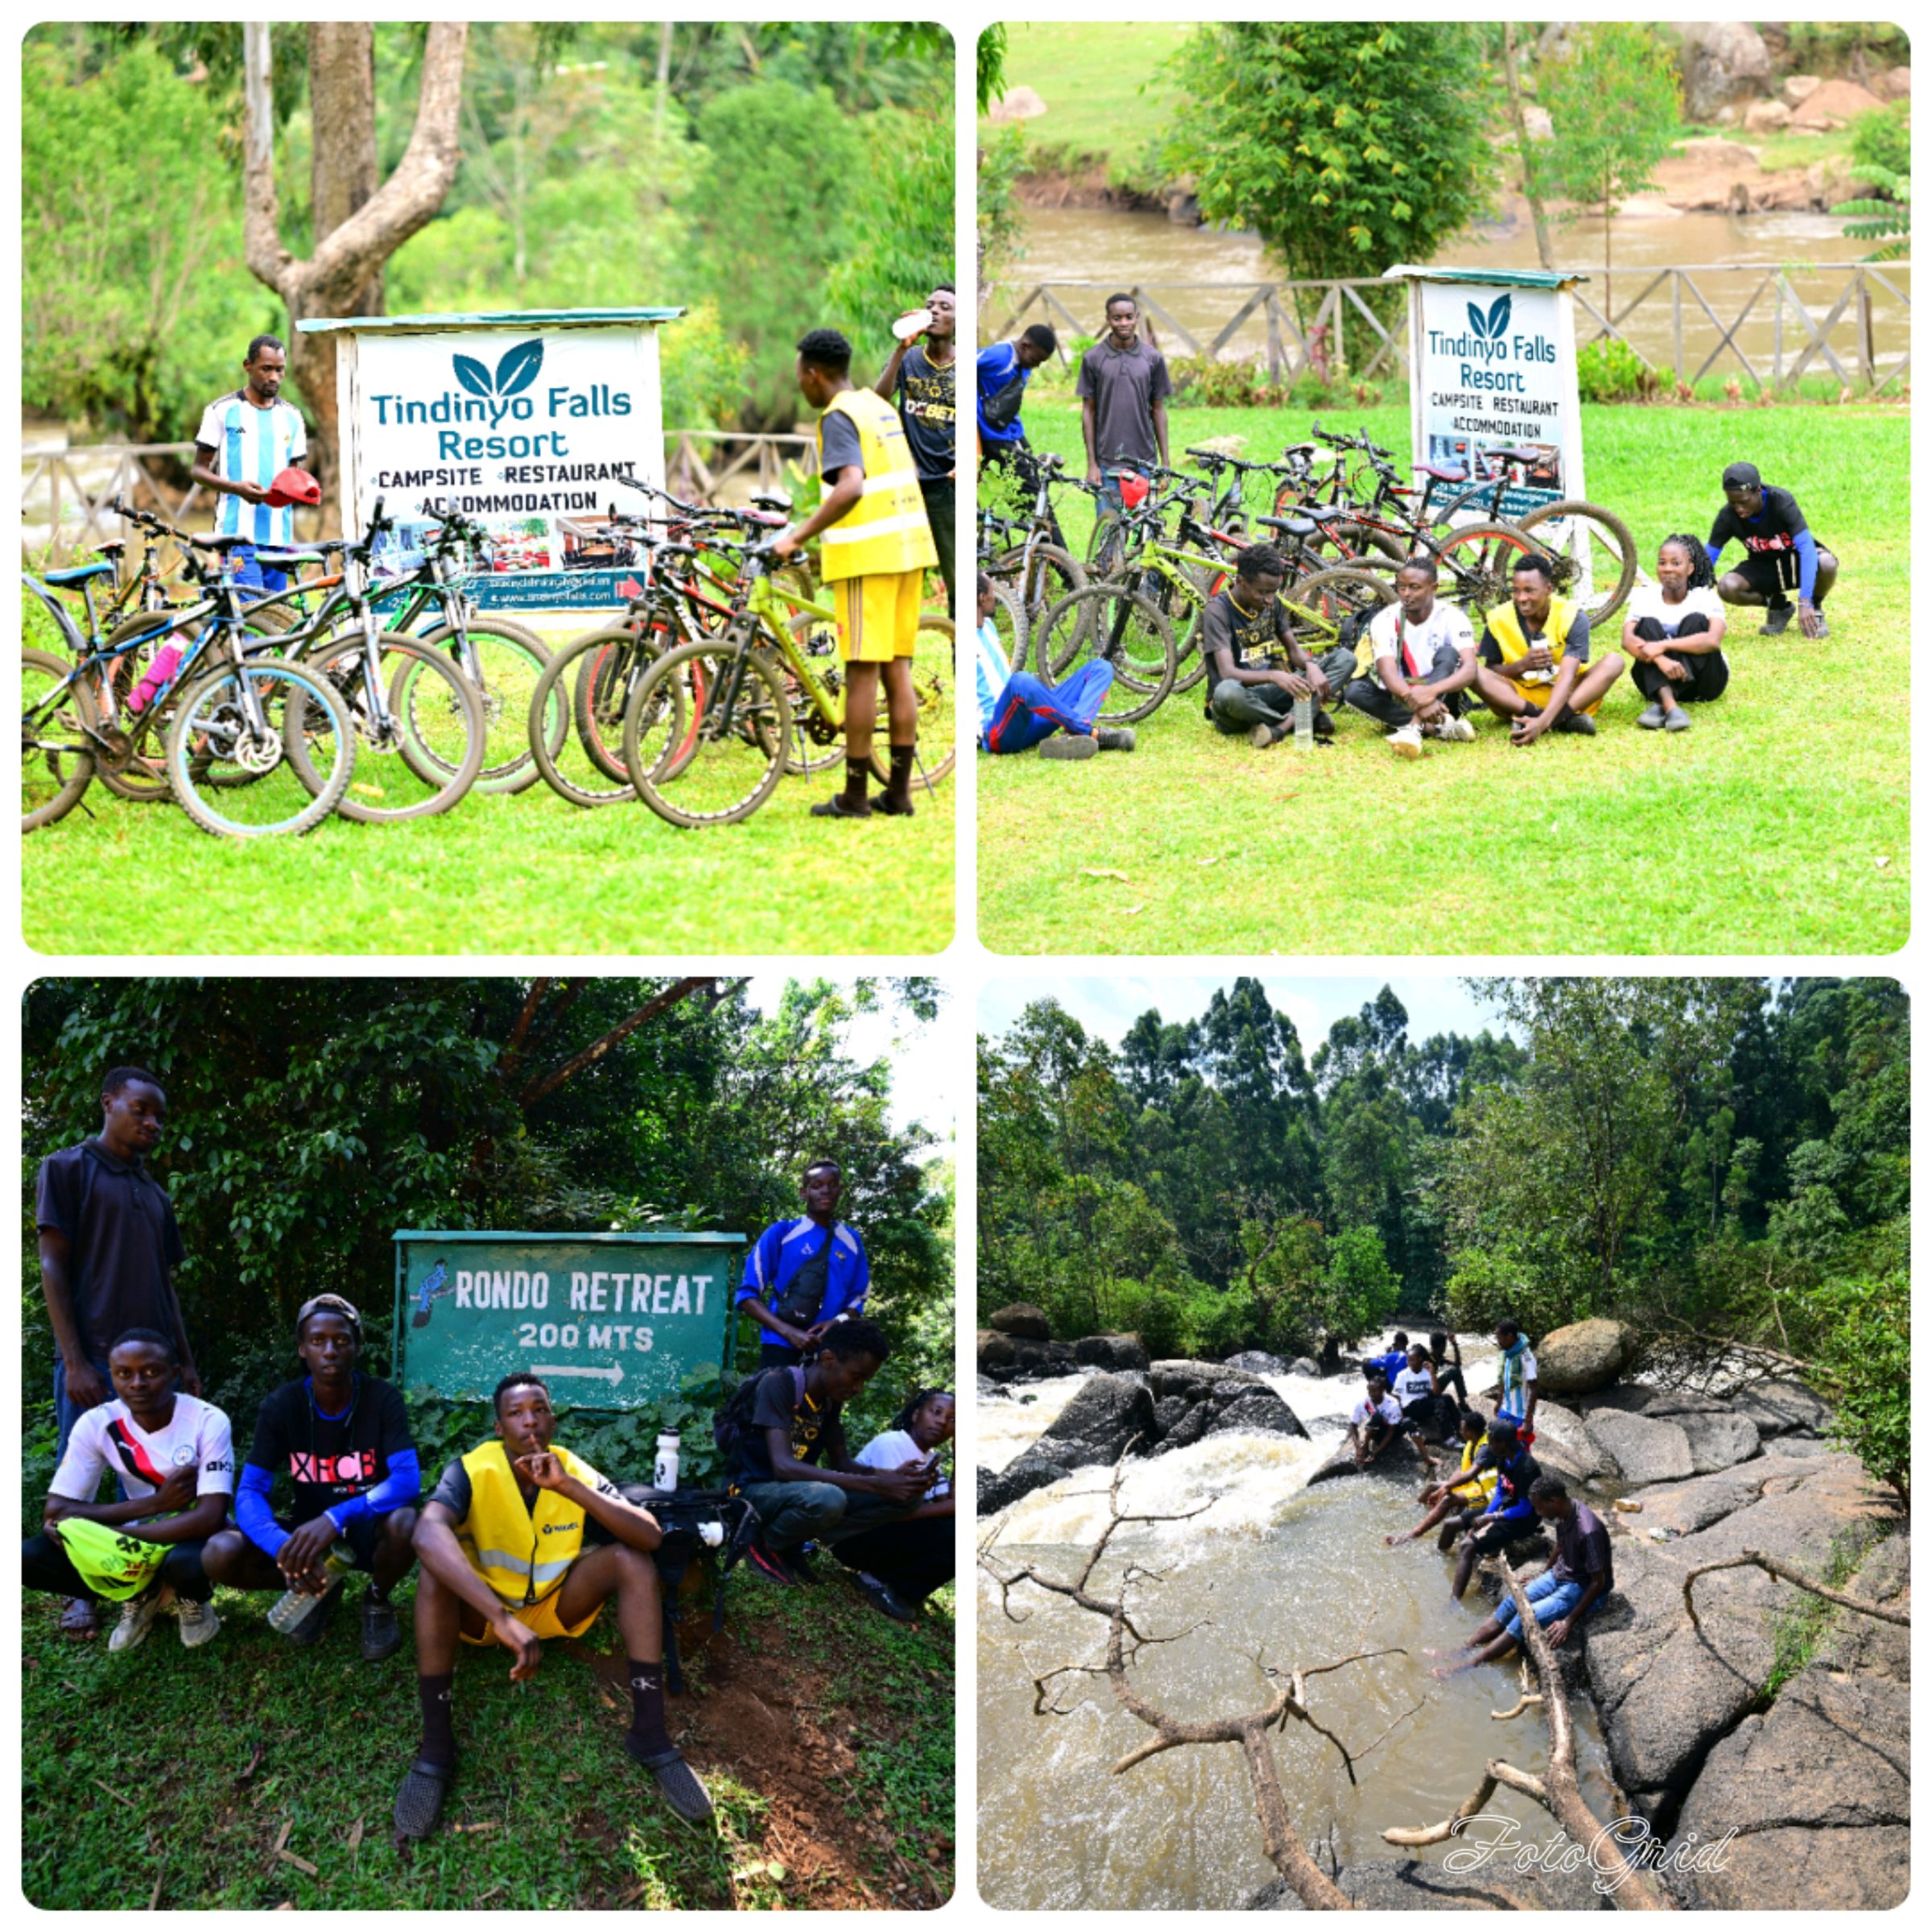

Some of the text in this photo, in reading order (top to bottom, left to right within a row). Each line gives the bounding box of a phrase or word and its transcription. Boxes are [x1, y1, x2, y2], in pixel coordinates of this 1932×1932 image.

[1428, 331, 1555, 366] Tindinyo Falls
[1461, 364, 1525, 393] Resort
[370, 385, 632, 429] Tindinyo Falls
[1431, 392, 1558, 415] CAMPSITE RESTAURANT
[1452, 416, 1542, 438] ACCOMMODATION
[438, 431, 569, 460] Resort
[379, 462, 636, 488] CAMPSITE RESTAURANT
[456, 1271, 713, 1314] RONDO RETREAT
[518, 1323, 654, 1352] 200 MTS
